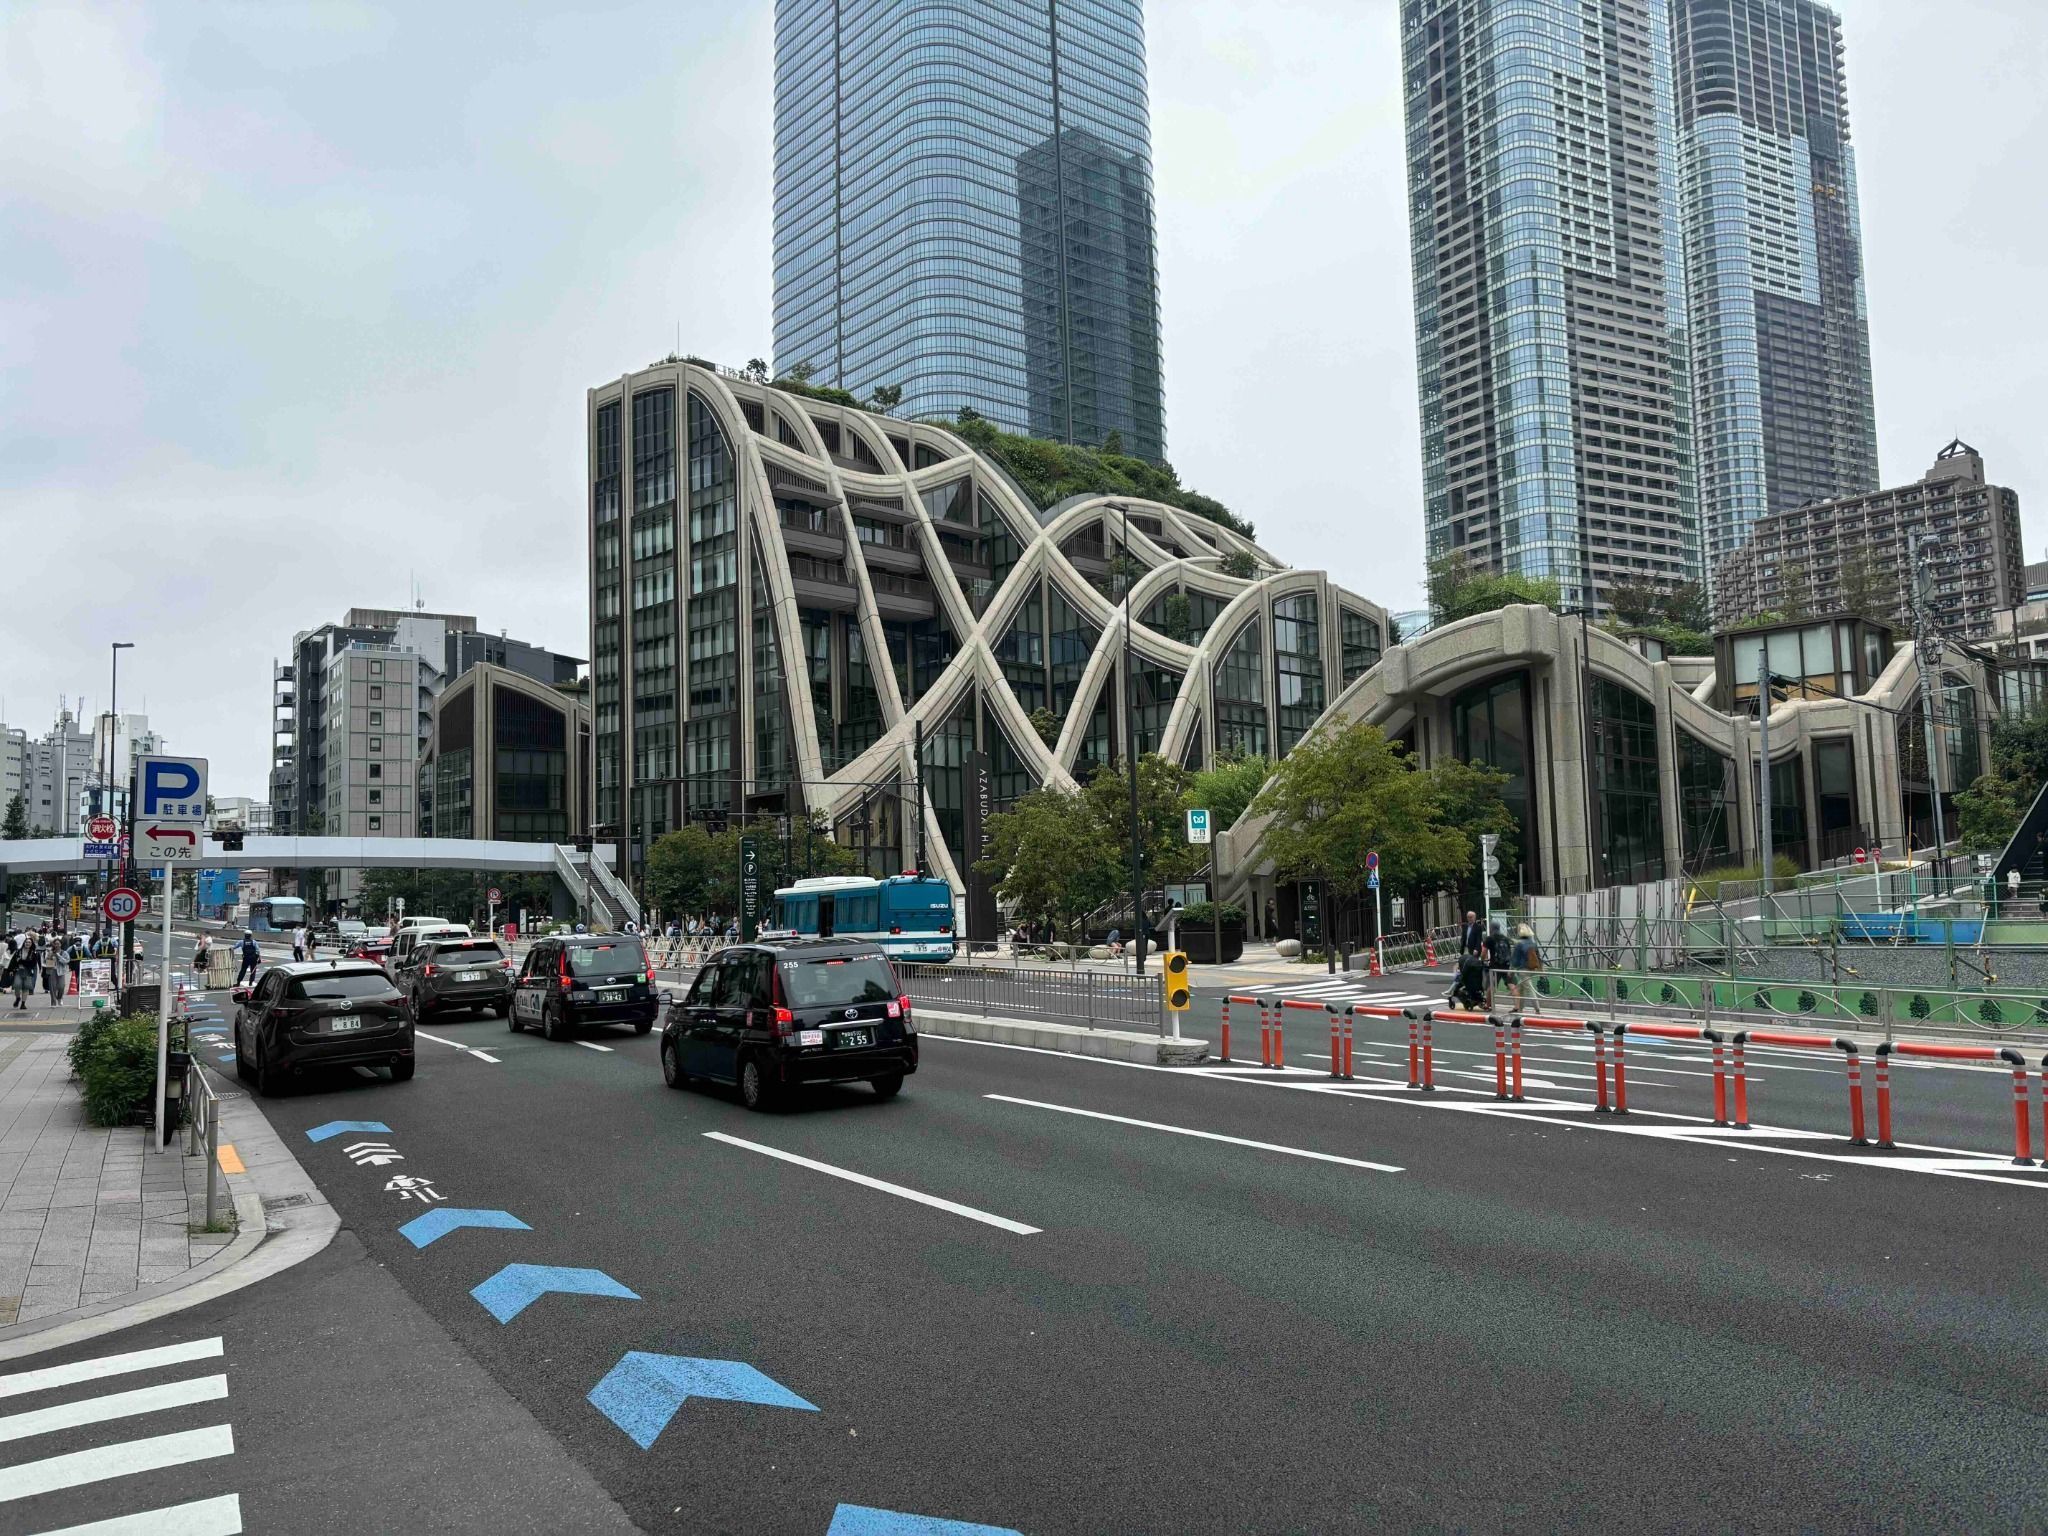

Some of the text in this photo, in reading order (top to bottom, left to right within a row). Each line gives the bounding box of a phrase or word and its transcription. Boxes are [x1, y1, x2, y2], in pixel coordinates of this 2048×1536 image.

[144, 761, 200, 815] P
[163, 804, 202, 816] 駐車場
[92, 824, 115, 833] 消火栓
[150, 846, 191, 859] この先
[748, 864, 754, 873] P
[112, 898, 133, 912] 50
[783, 961, 799, 969] 255
